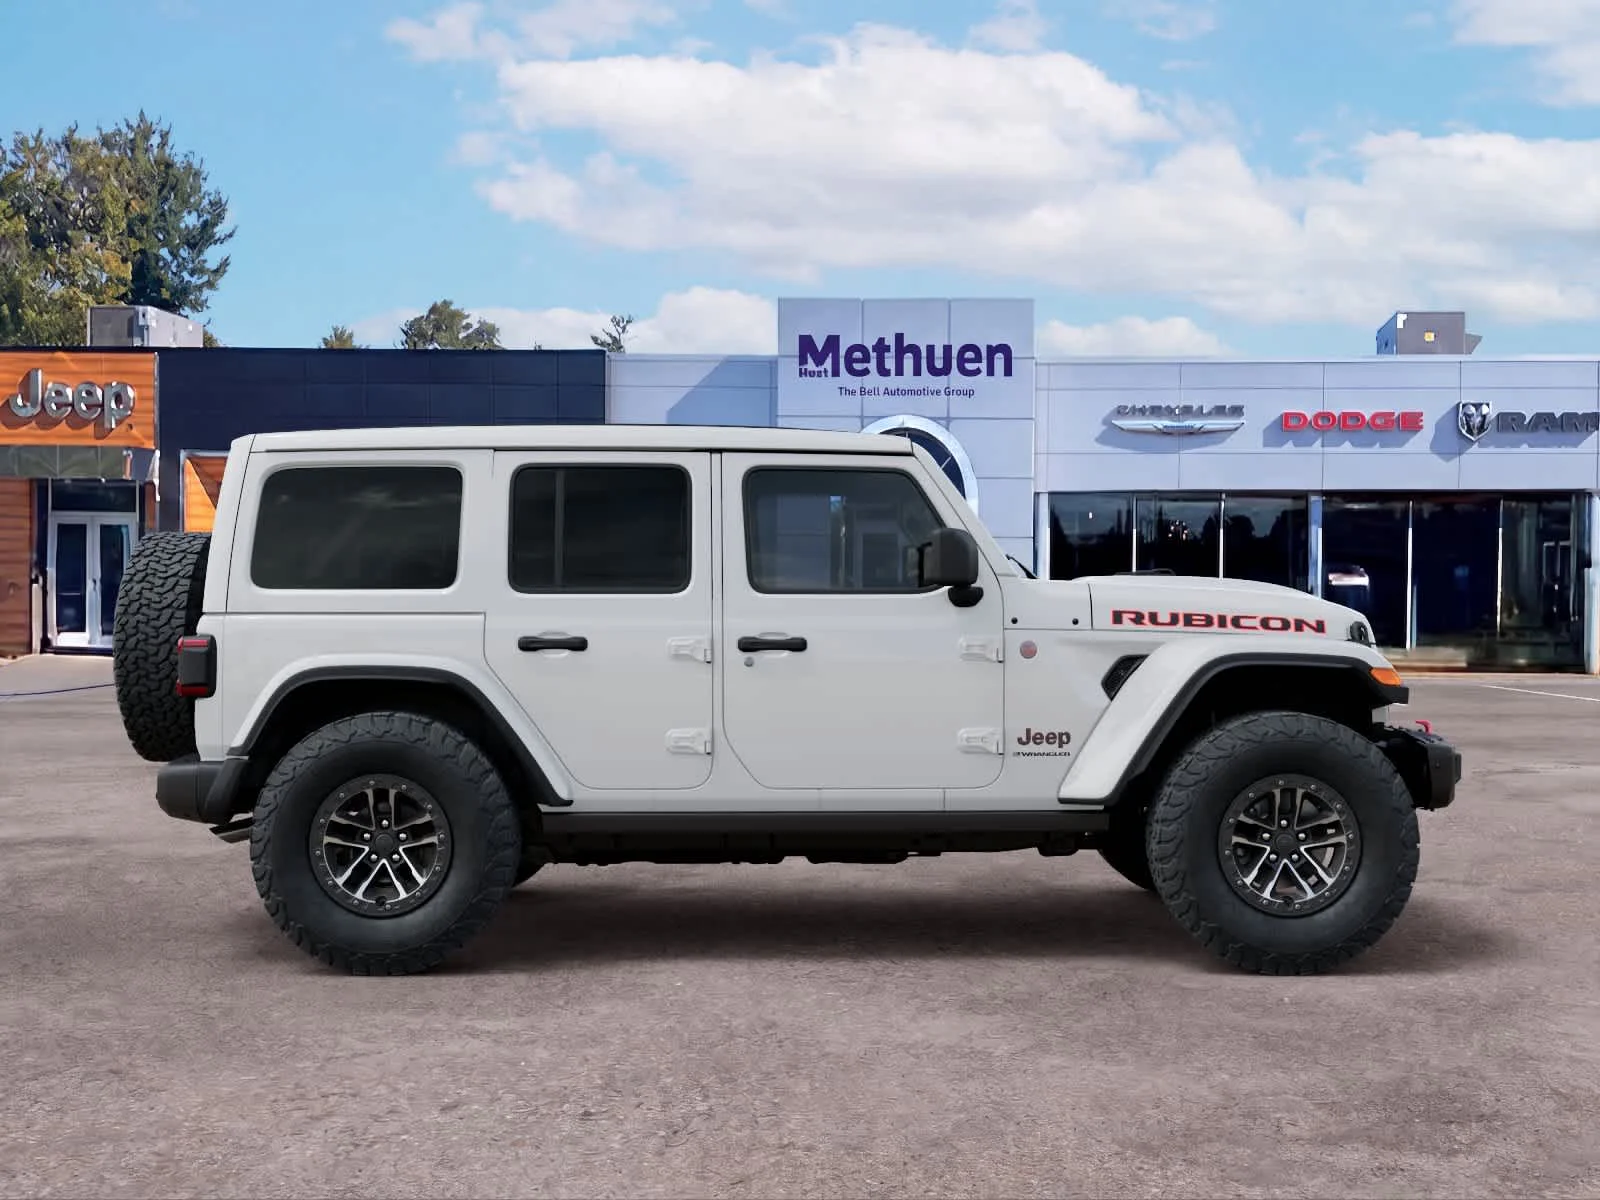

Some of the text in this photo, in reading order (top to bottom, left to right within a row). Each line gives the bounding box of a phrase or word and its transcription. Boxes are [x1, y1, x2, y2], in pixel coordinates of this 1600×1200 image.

[798, 333, 1013, 378] Methuen
[8, 367, 136, 430] Jeep
[838, 386, 975, 398] The Bell Automotive Group
[1281, 410, 1425, 433] DODGE
[1497, 411, 1600, 433] RAM
[1111, 609, 1327, 634] RUBICON
[1017, 727, 1071, 749] Jeep
